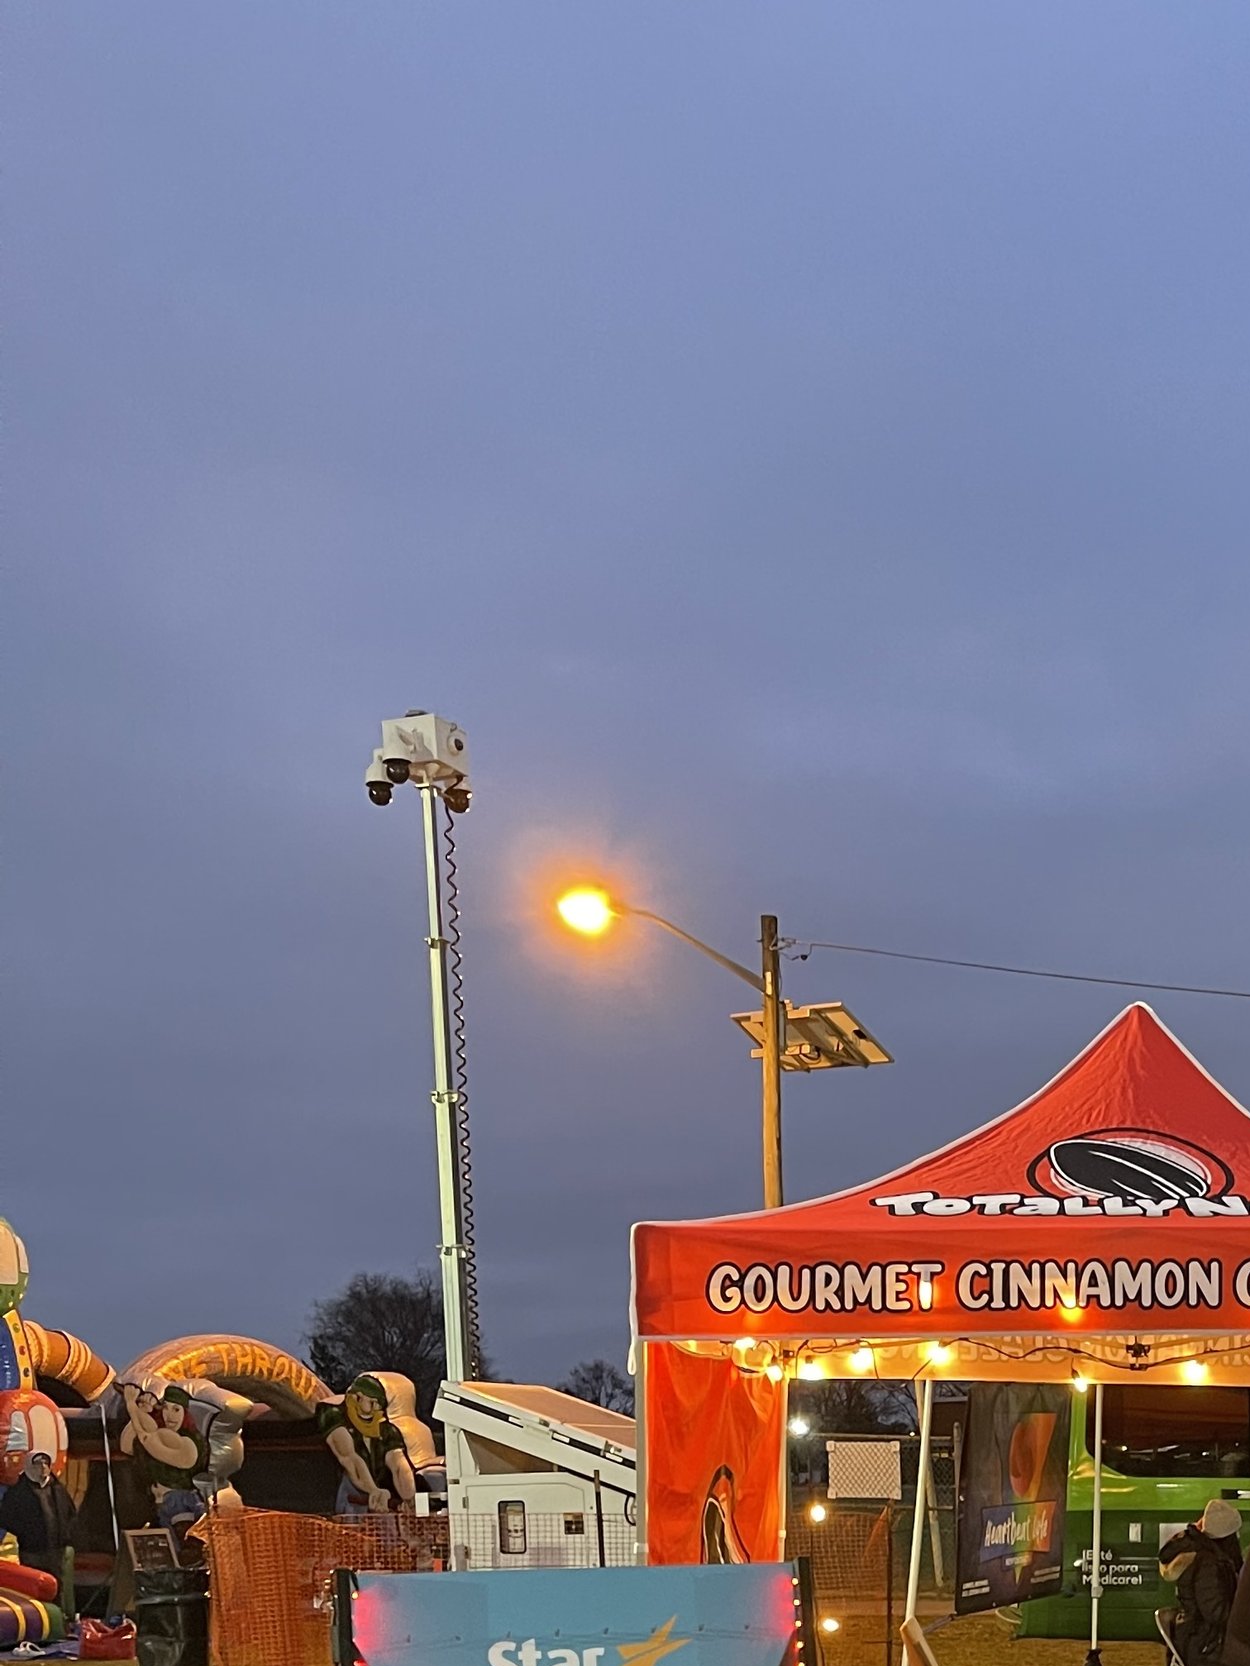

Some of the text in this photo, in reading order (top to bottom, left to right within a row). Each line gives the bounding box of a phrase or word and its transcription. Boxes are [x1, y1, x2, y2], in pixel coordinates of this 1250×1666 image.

[707, 1261, 943, 1313] GOURMET
[956, 1258, 1222, 1310] CINNAMON
[1109, 1564, 1139, 1574] para
[1082, 1574, 1142, 1585] Mdicare!
